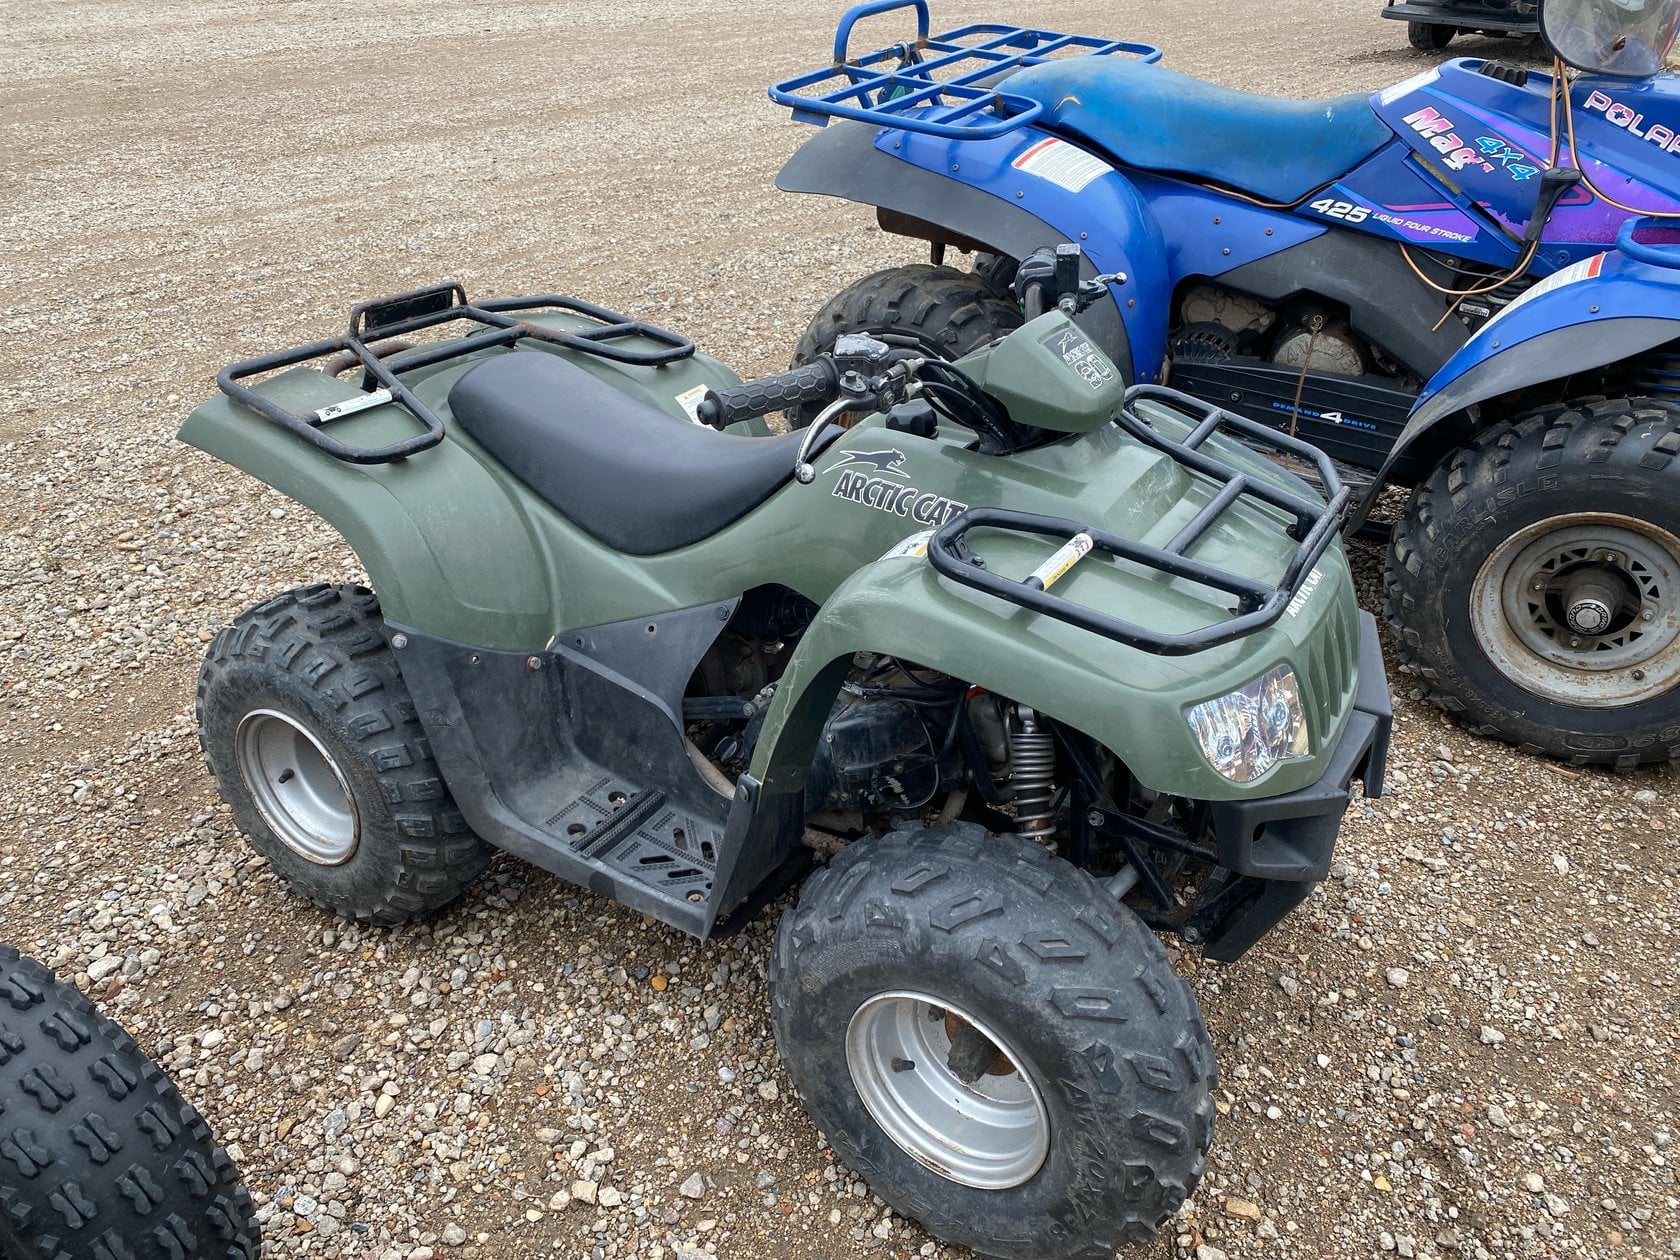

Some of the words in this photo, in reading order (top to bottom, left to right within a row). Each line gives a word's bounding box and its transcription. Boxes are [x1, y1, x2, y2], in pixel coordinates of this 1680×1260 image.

[1310, 198, 1372, 223] 425
[1373, 211, 1404, 225] LIQUID
[1403, 221, 1430, 233] FOUR
[1429, 228, 1472, 243] STROKE
[1272, 402, 1321, 417] DEMAND
[1320, 412, 1343, 424] 4
[1343, 418, 1377, 430] DRIVE
[831, 469, 919, 518] ARCTIC
[911, 493, 969, 527] CAT
